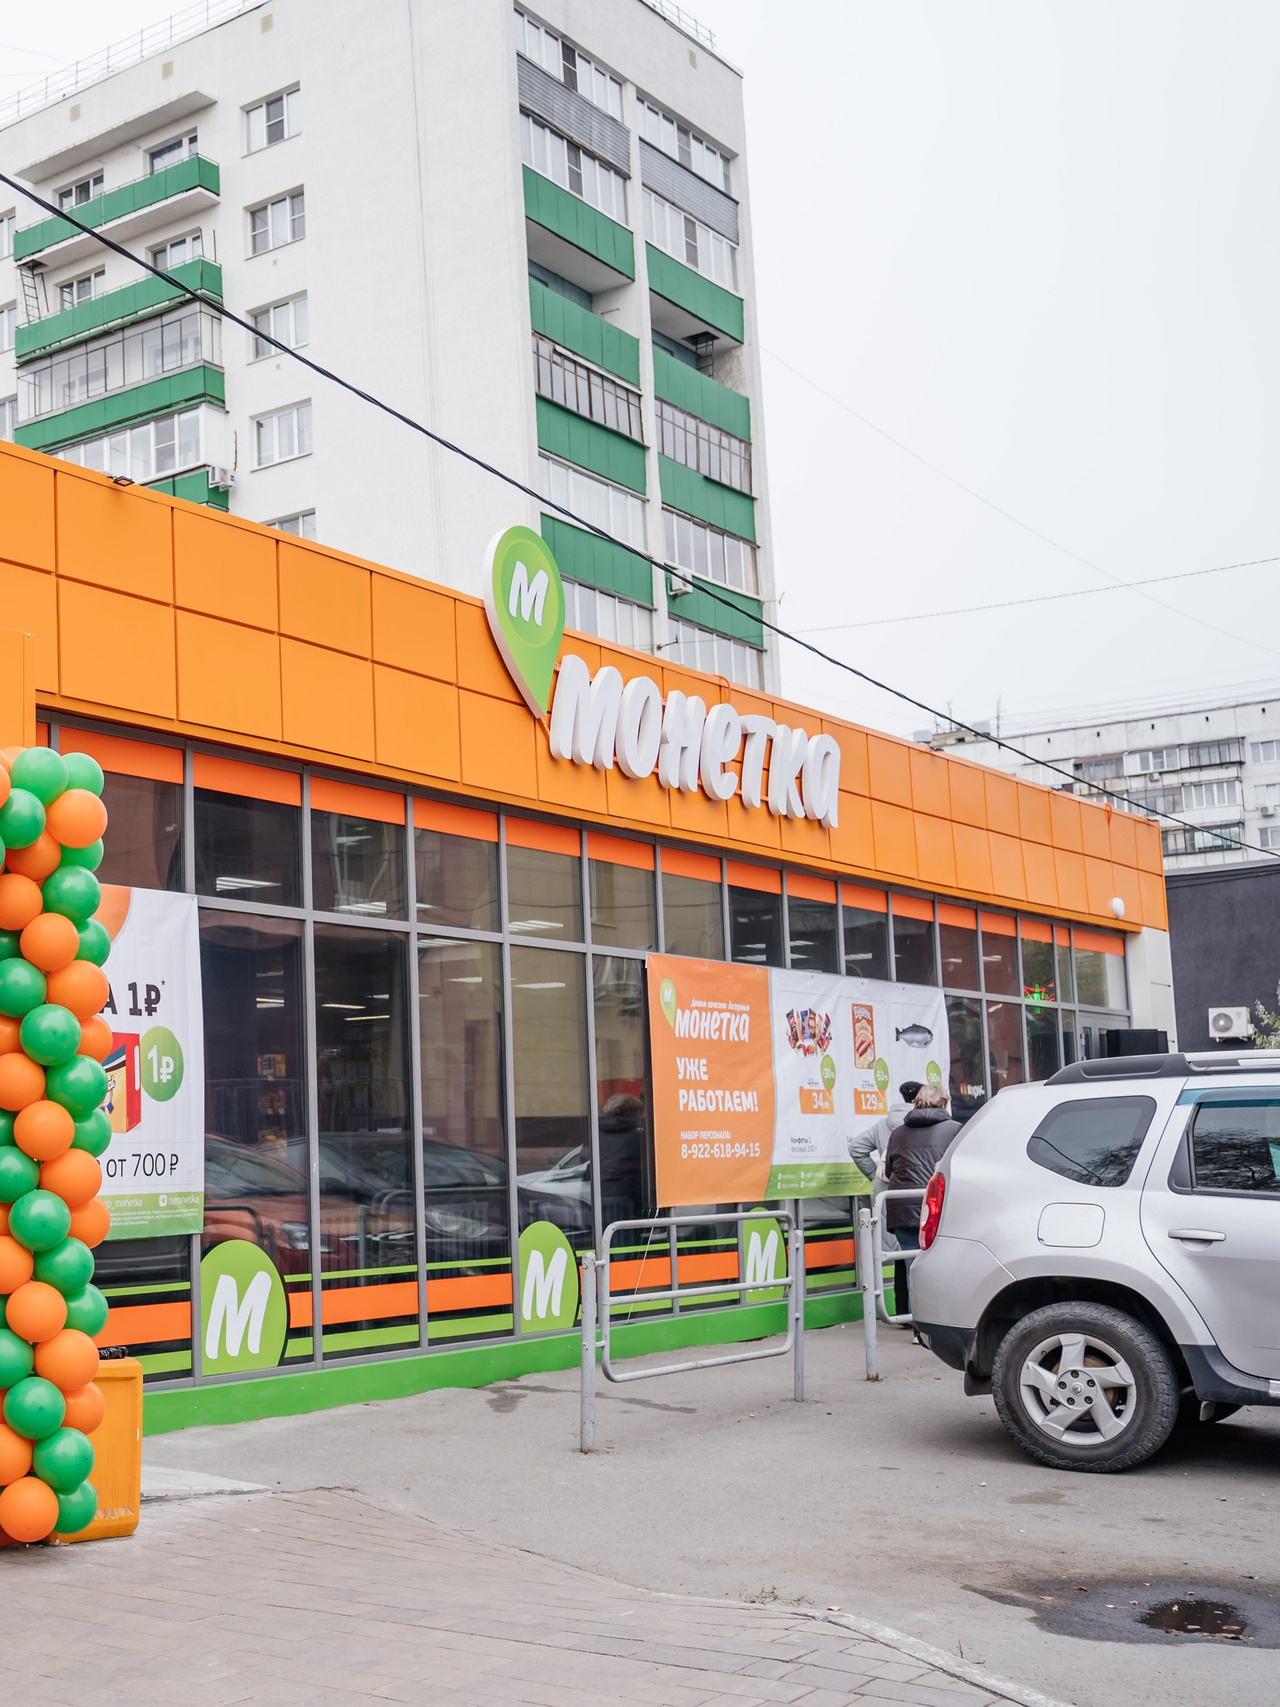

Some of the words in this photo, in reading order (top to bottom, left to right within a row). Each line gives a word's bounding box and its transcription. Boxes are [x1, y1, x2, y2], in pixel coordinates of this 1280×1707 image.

[675, 1057, 709, 1081] УЖЕ
[679, 1089, 759, 1112] РАБОТАЕМ!
[680, 1131, 699, 1140] НАБОР
[699, 1131, 731, 1140] ПЕРСОНАЛА:
[681, 1143, 761, 1159] 8-922-618-94-15
